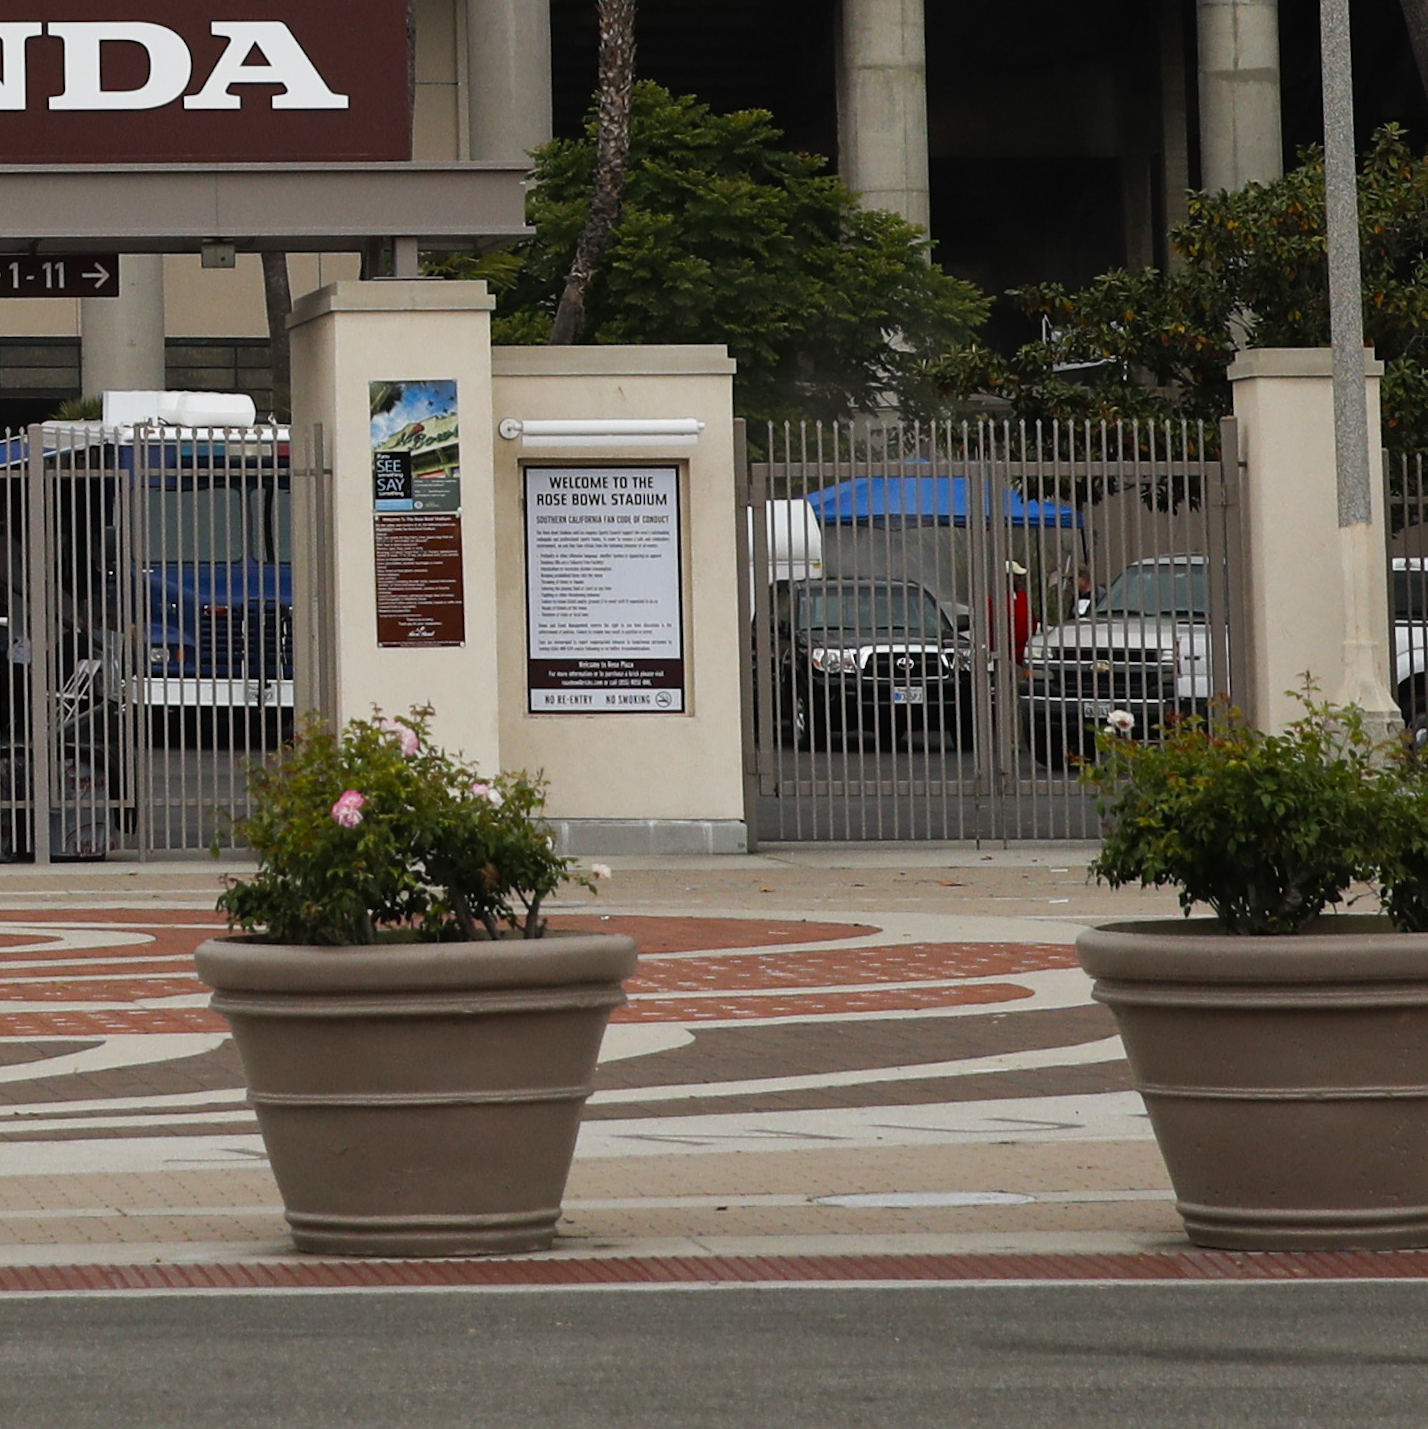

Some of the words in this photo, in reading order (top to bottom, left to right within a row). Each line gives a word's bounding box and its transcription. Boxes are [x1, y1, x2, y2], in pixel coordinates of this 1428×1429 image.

[376, 459, 401, 473] SEE
[376, 478, 405, 491] SAY
[549, 476, 608, 489] WELCOME
[612, 476, 627, 489] TO
[631, 476, 654, 489] THE
[536, 493, 567, 506] ROSE
[572, 493, 606, 506] BOWL
[611, 493, 667, 506] STADIUM
[536, 515, 567, 524] SOUTHERN
[568, 515, 602, 524] CALIFORNIA
[603, 515, 616, 524] FAN
[616, 515, 631, 524] CODE
[633, 515, 640, 524] OF
[642, 515, 669, 524] CONDUCT
[545, 694, 555, 704] NO
[557, 694, 593, 704] RE-ENTRY
[605, 694, 616, 704] NO
[618, 694, 651, 704] SMOKING
